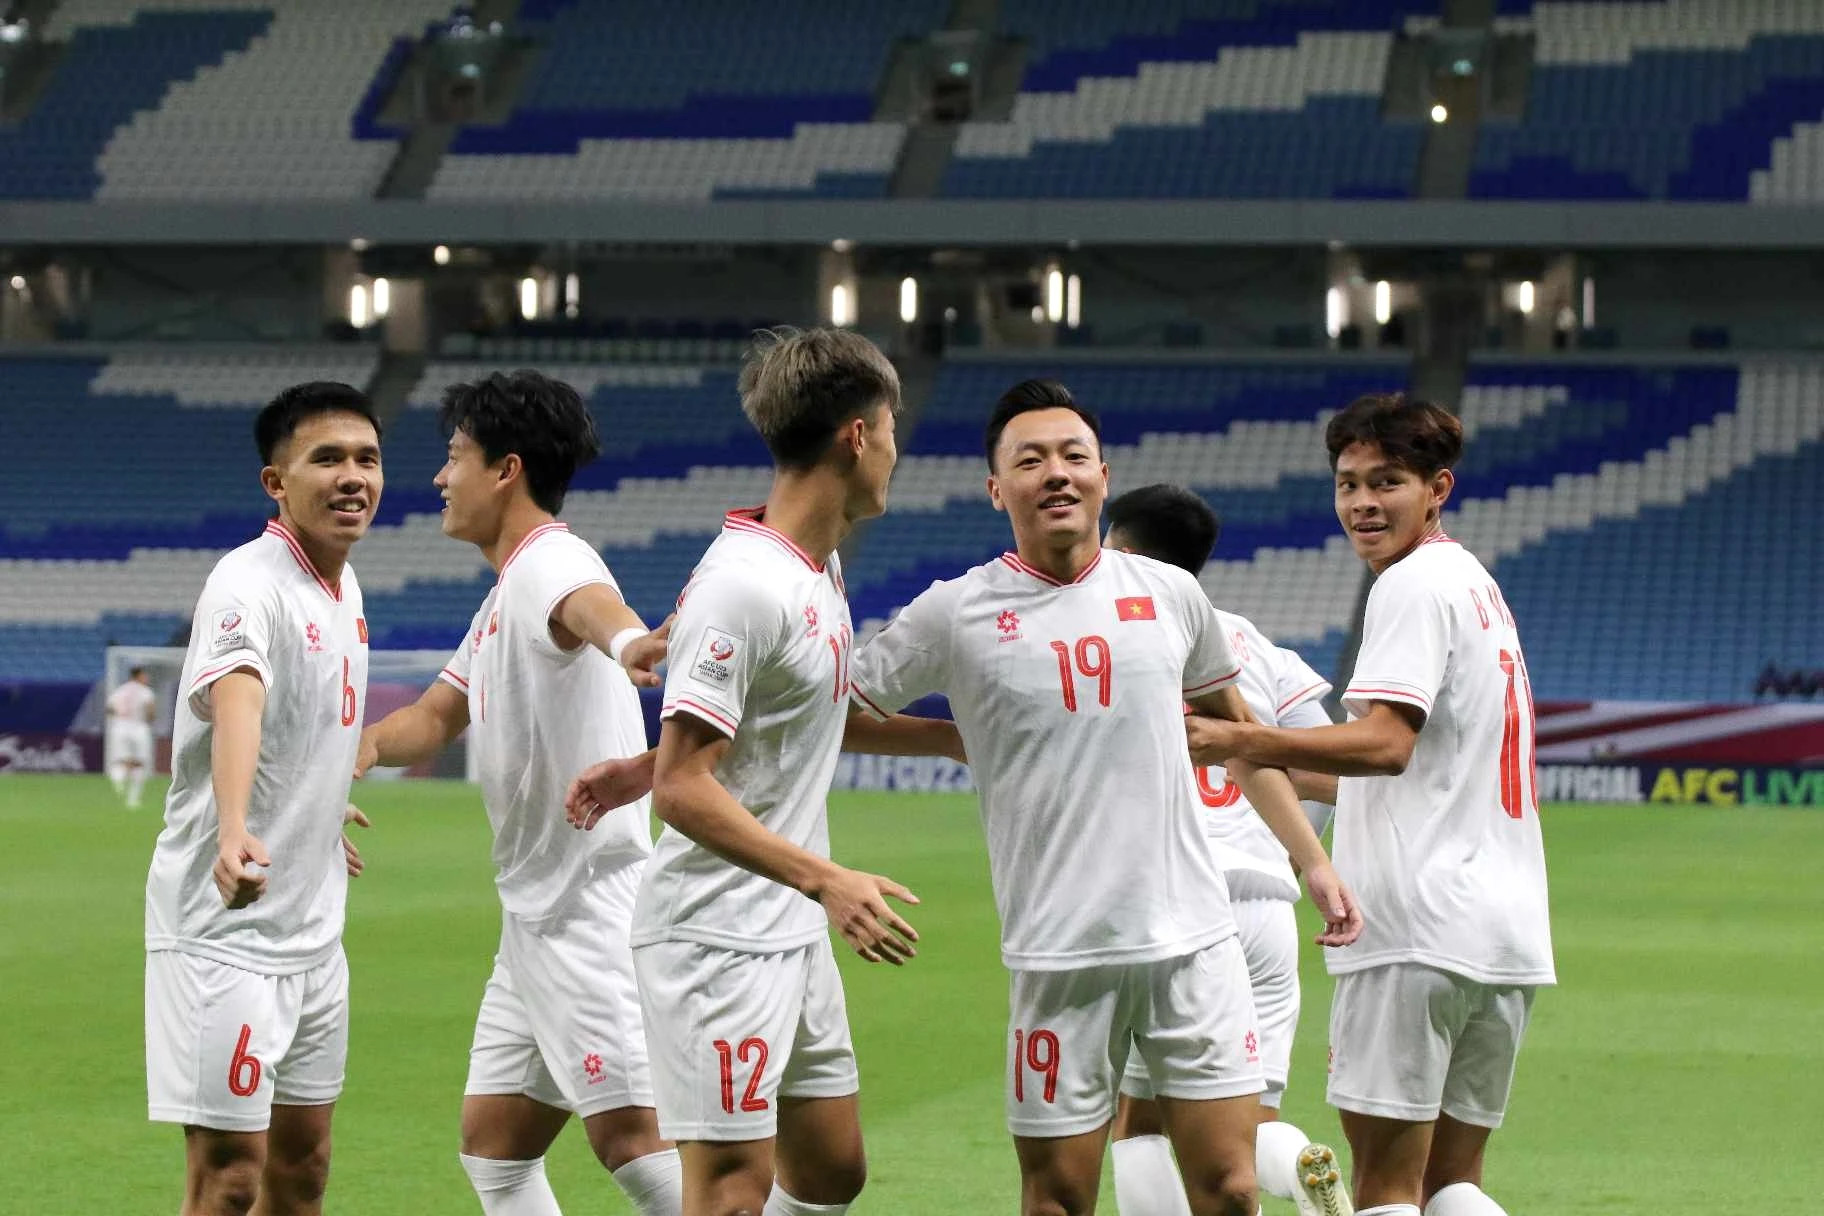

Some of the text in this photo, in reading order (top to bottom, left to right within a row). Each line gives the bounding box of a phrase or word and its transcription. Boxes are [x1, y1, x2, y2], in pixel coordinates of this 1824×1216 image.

[341, 655, 356, 727] 6
[1049, 635, 1112, 713] 19
[1651, 768, 1739, 804] AFC
[228, 1023, 261, 1097] 6
[713, 1036, 769, 1114] 12
[1015, 1028, 1060, 1104] 19
